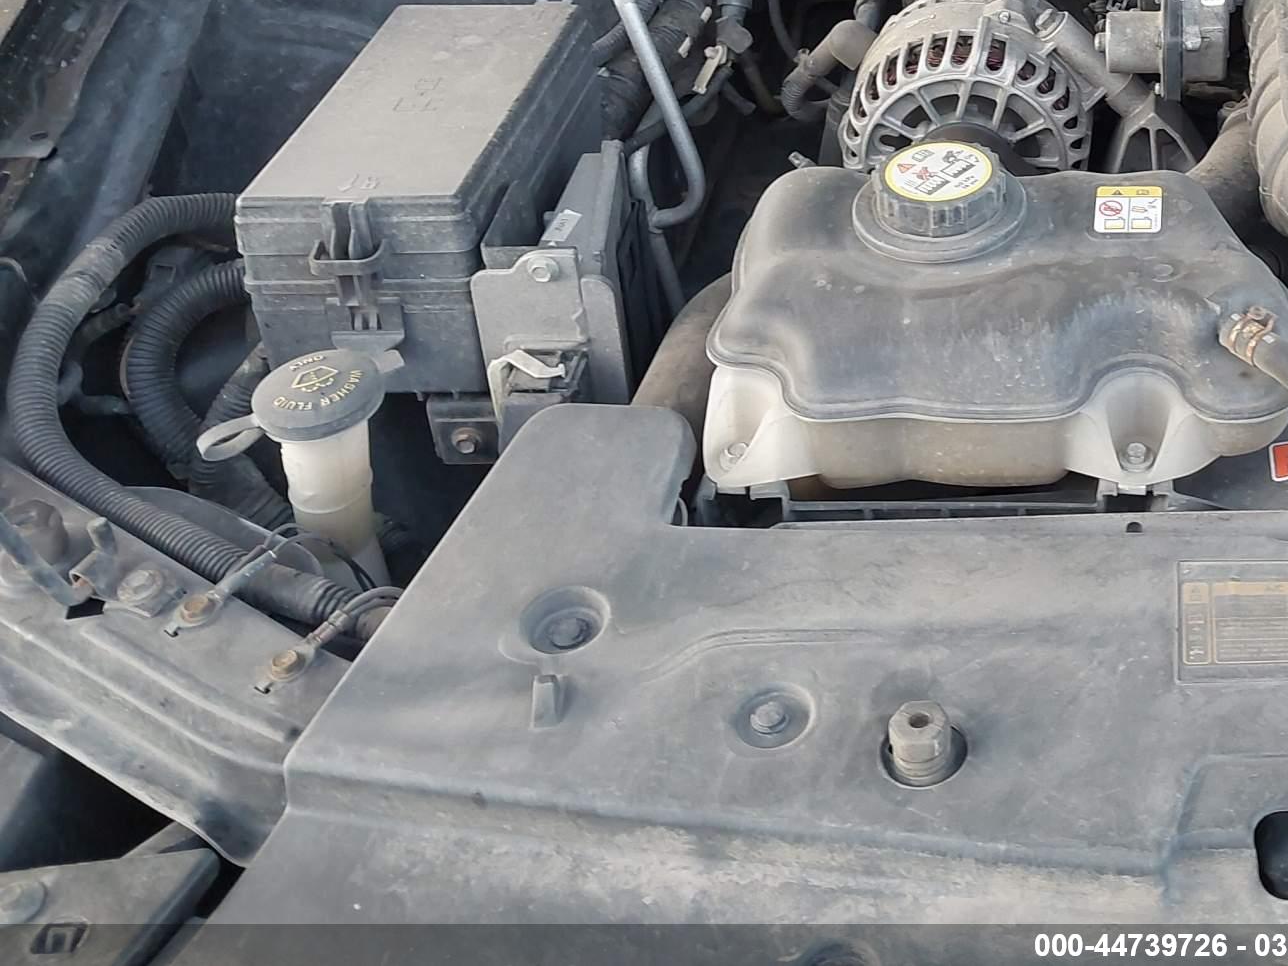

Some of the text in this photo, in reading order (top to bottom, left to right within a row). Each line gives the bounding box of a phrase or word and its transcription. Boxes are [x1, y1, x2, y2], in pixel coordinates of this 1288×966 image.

[289, 354, 325, 372] ONLY
[272, 369, 363, 411] WASHER FLUID
